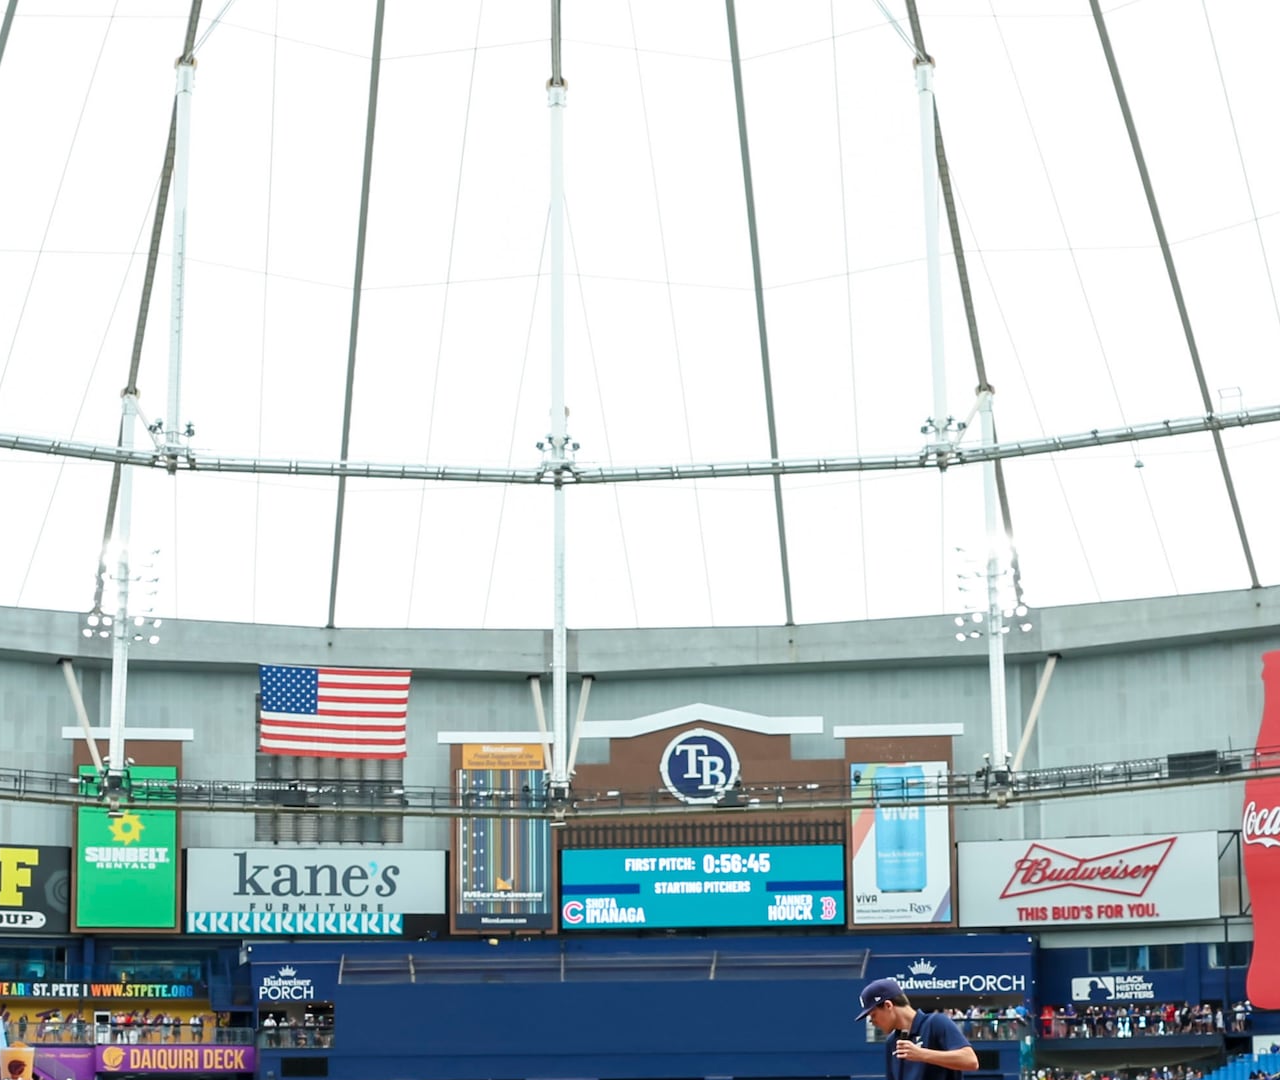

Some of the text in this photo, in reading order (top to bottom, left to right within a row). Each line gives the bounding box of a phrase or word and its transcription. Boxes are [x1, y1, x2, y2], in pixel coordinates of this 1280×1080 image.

[675, 744, 726, 791] TB
[625, 853, 770, 873] FIRST PITCH: 0:56:45
[1015, 857, 1159, 885] Budweiser
[233, 851, 400, 897] kane's
[654, 880, 751, 894] STARTING PITCHERS
[249, 903, 384, 913] FURNITURE
[585, 897, 618, 910] SHOTA
[774, 894, 813, 907] TANNER
[586, 907, 646, 924] IMANAGA
[767, 905, 813, 921] HOUCK
[1017, 903, 1160, 921] THIS BUD'S FOR YOU.
[959, 975, 1025, 992] PORCH
[1115, 976, 1144, 985] BLACK
[1115, 983, 1153, 993] HISTORY
[10, 982, 31, 996] ARE
[91, 983, 193, 998] WWW.STPETE.ORG
[259, 986, 314, 1000] PORCH
[1115, 990, 1155, 1000] MATTERS
[130, 1048, 246, 1071] DAIQUIRI DECK
